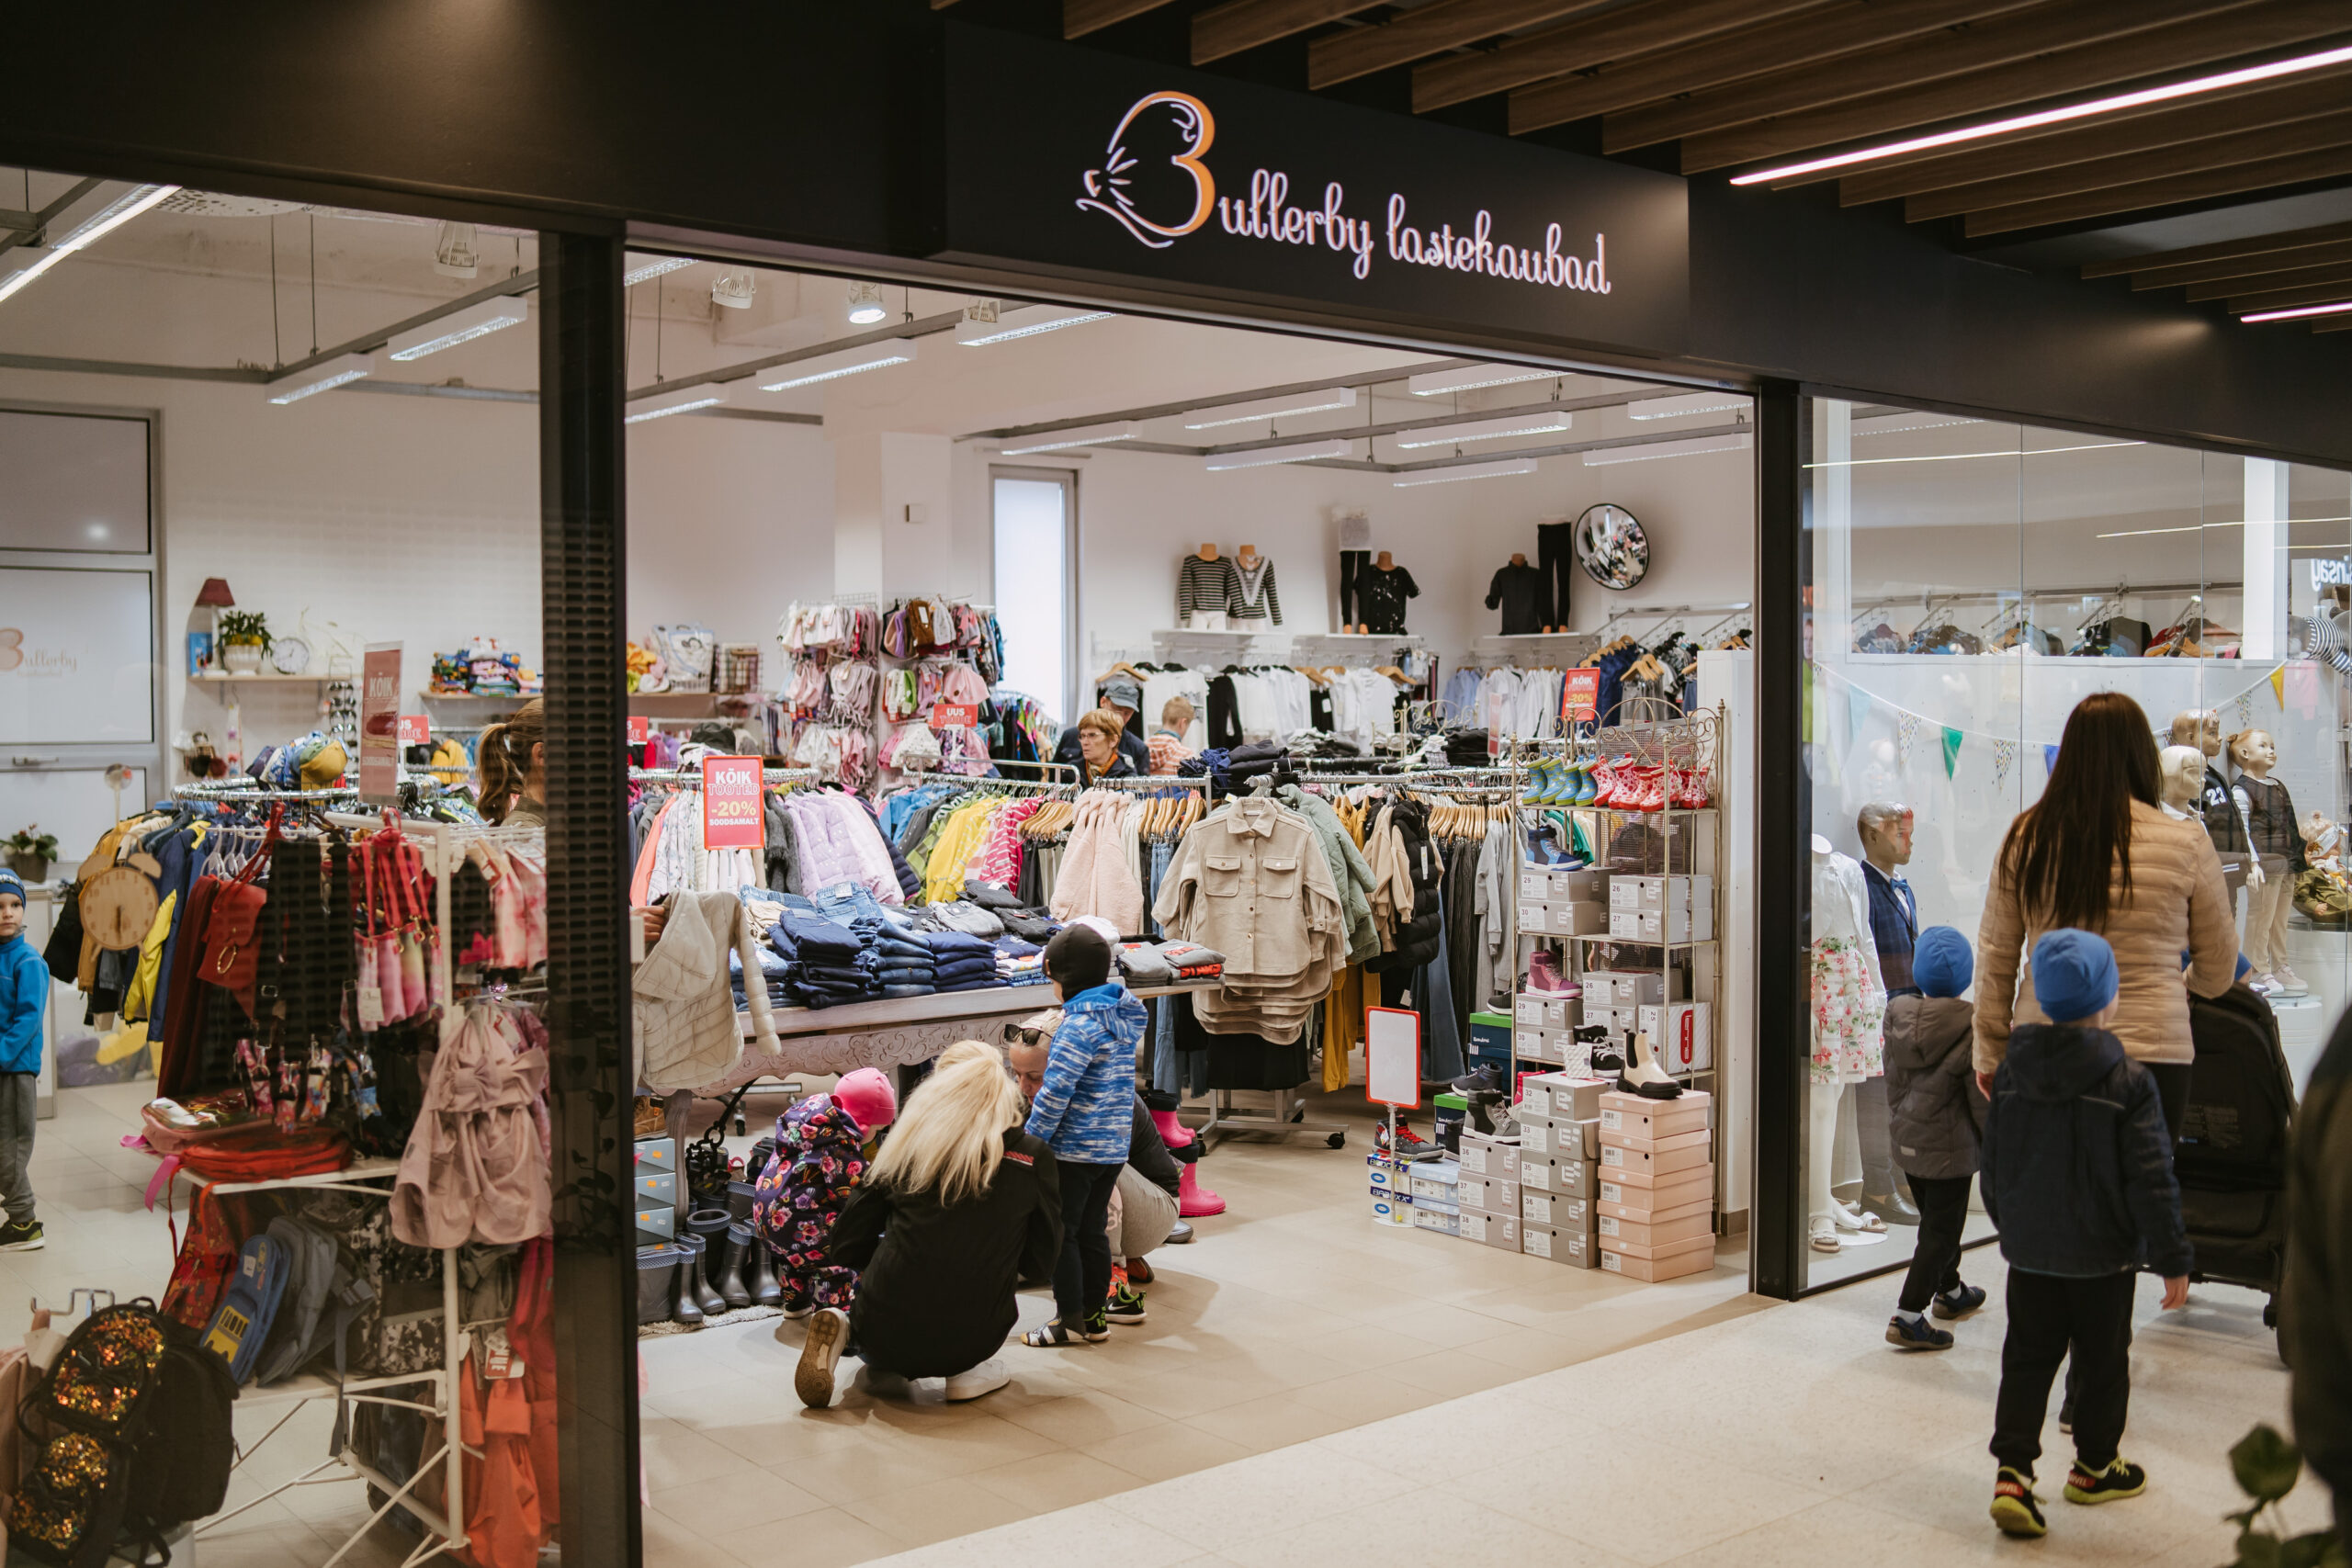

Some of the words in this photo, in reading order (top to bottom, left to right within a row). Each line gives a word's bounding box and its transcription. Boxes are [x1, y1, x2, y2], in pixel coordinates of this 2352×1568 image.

[1386, 193, 1611, 295] lastekaubad
[946, 707, 966, 716] UUS
[715, 767, 752, 784] KÕIK
[707, 783, 760, 796] TOOTED
[2206, 786, 2227, 807] 23
[711, 800, 757, 817] -20%
[708, 818, 760, 827] SOODSAMALT
